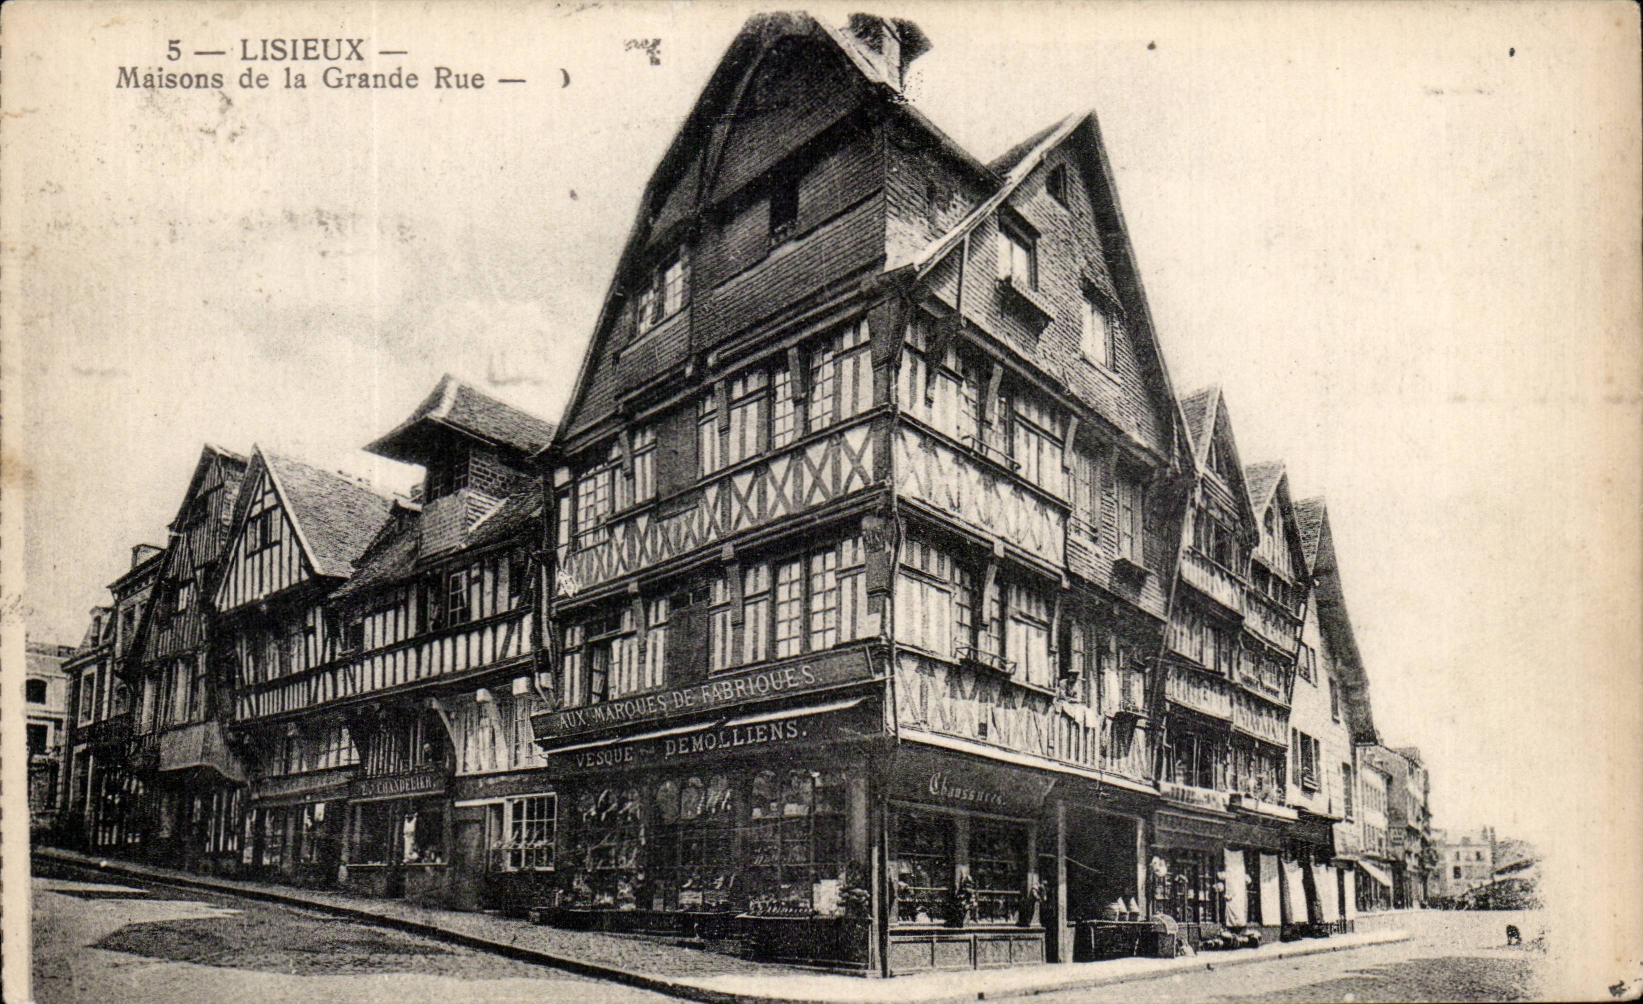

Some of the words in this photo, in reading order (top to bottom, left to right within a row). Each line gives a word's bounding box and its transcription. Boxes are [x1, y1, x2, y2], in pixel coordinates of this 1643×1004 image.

[593, 693, 668, 722] MARQUES
[672, 689, 695, 709] DE
[576, 746, 634, 768] VESQUE
